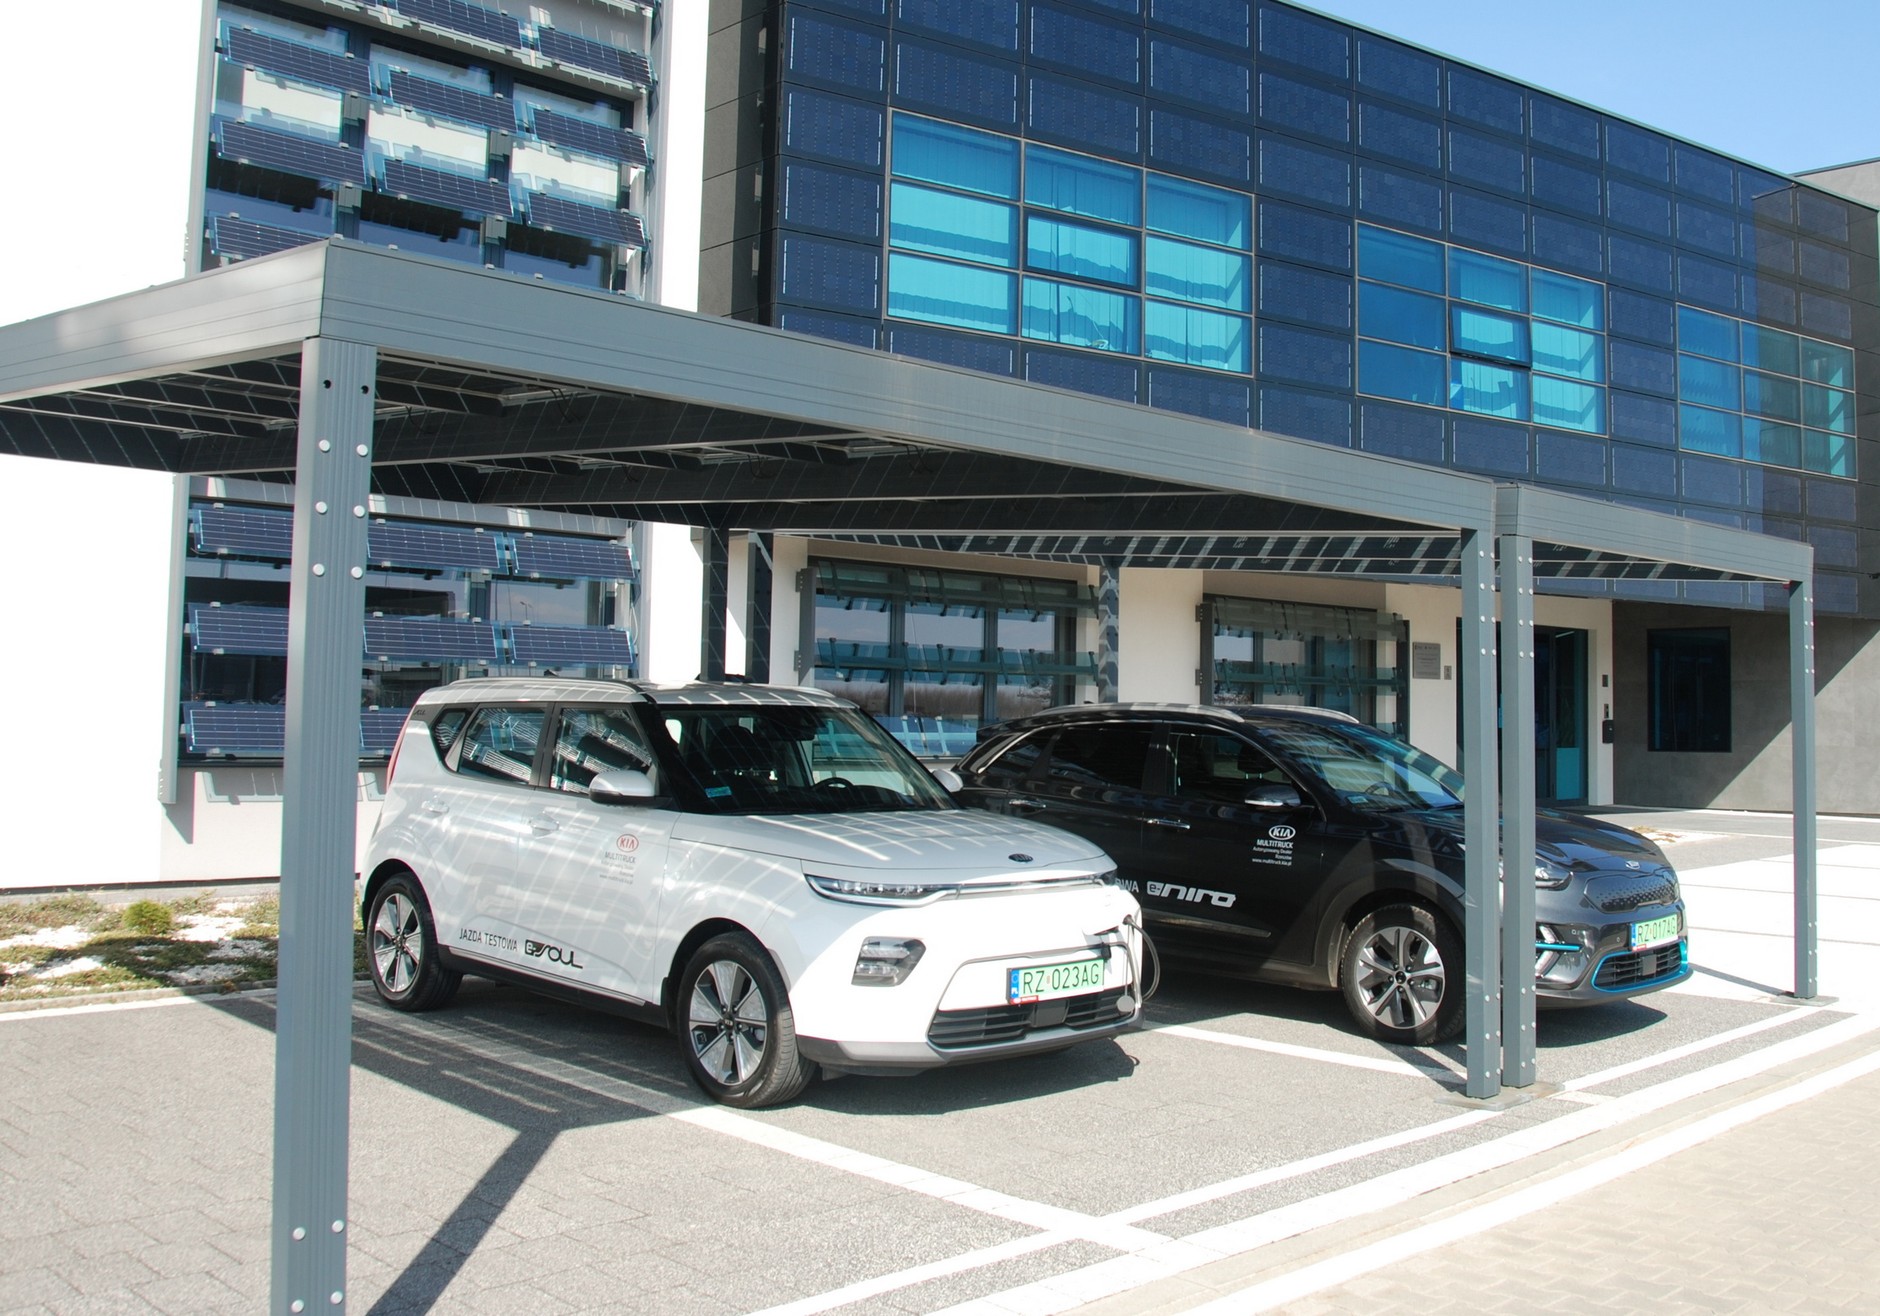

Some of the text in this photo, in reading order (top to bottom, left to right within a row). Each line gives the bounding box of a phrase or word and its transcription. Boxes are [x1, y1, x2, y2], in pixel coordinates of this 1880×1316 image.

[1256, 839, 1294, 849] MULTITRUCK
[604, 851, 637, 864] MULTITRUCK
[459, 927, 482, 943] JAZDA
[483, 932, 518, 951] TESTOWA
[1637, 923, 1650, 944] RZ
[1023, 970, 1045, 994] RZ
[1051, 963, 1100, 990] 023AG
